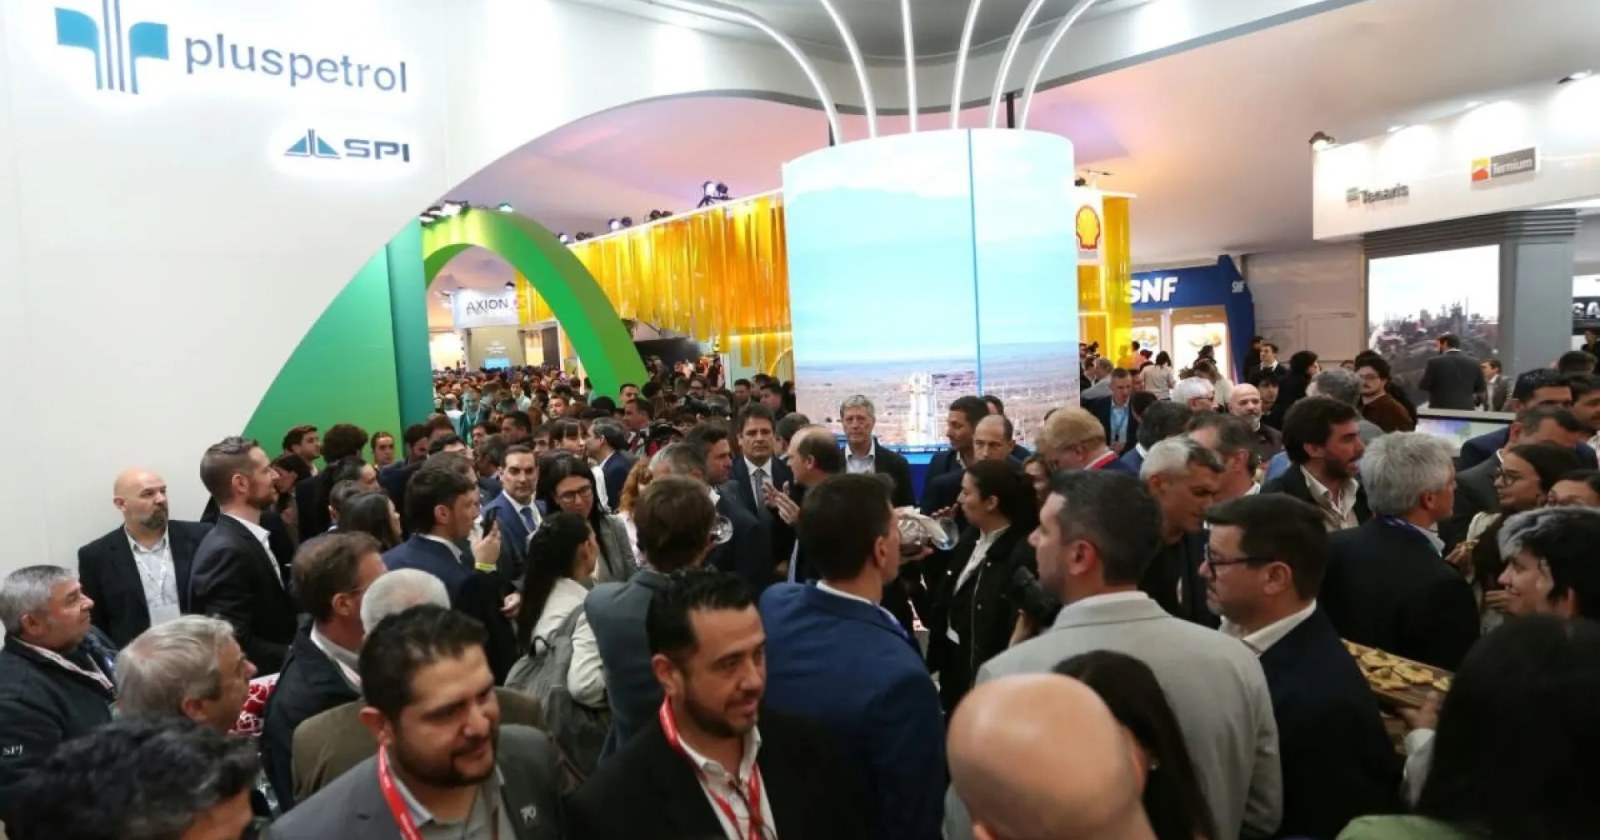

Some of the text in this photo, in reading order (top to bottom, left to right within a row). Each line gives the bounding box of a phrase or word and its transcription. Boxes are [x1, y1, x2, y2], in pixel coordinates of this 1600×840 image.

[185, 33, 407, 93] pluspetrol
[344, 138, 410, 163] SPI
[1123, 276, 1179, 304] SNF
[466, 299, 508, 313] AXION
